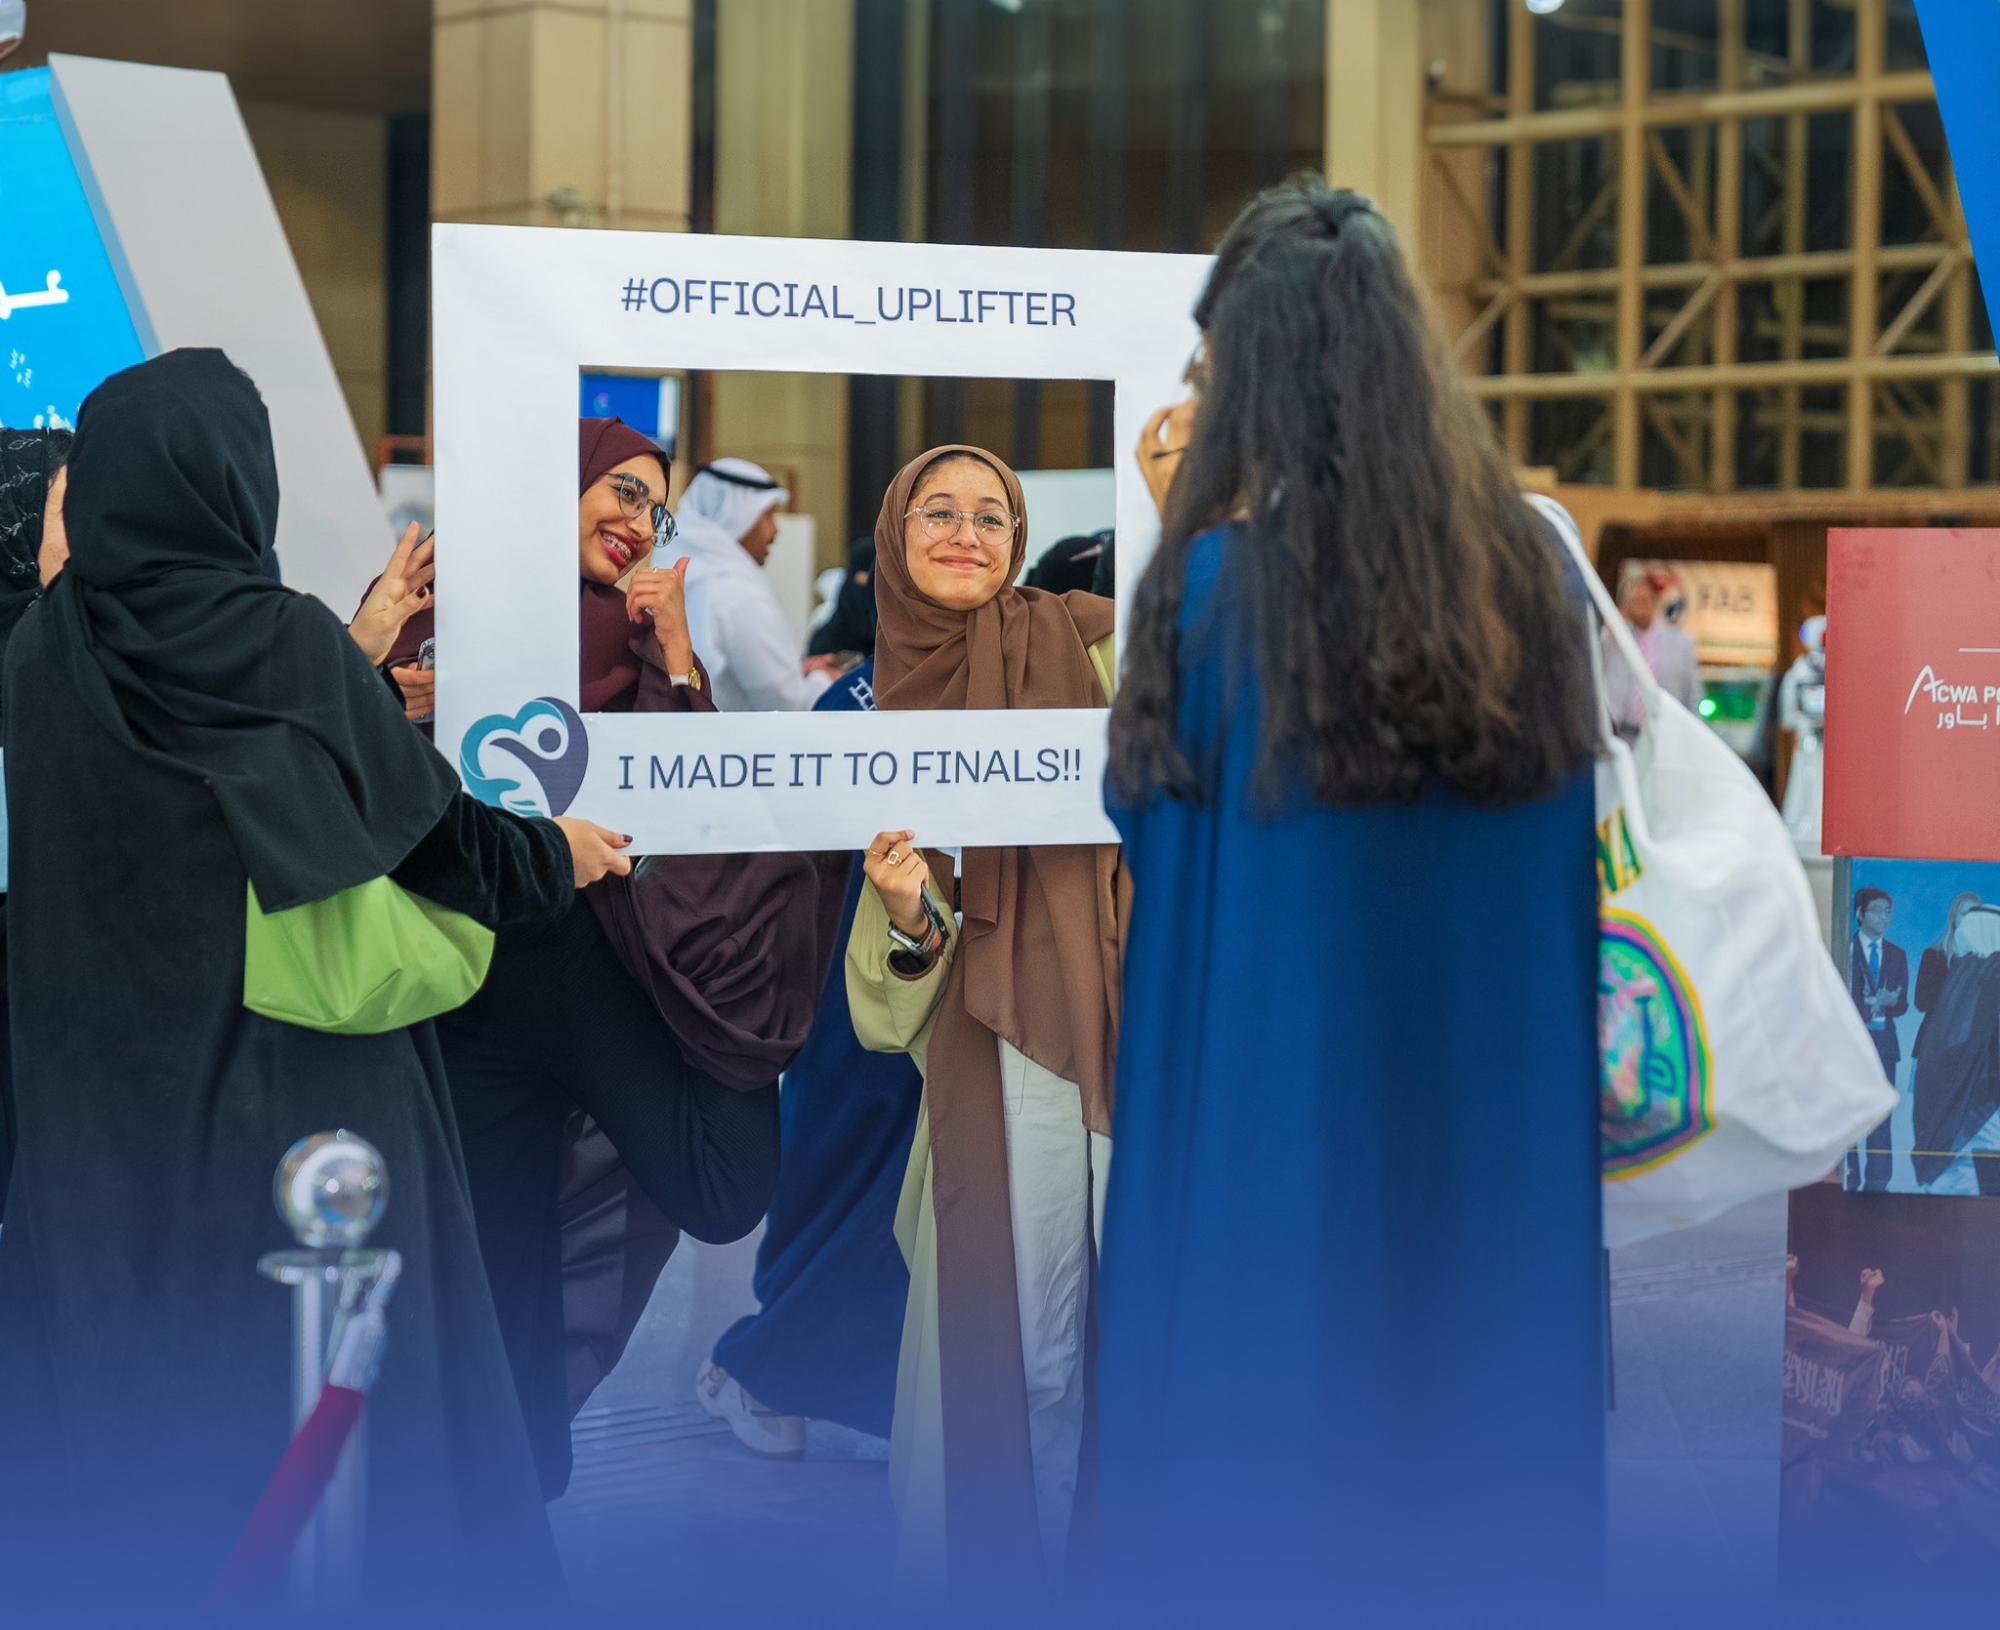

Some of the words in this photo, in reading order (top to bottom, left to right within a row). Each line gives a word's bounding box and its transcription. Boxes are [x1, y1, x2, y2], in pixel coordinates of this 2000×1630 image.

[621, 277, 1077, 326] #OFFICIAL_UPLIFTER
[1904, 664, 1979, 715] ACWA
[1983, 685, 2000, 704] P
[618, 755, 635, 790] I
[649, 754, 777, 789] MADE
[789, 753, 833, 788] IT
[843, 750, 899, 786] TO
[911, 748, 1082, 785] FINALS!!
